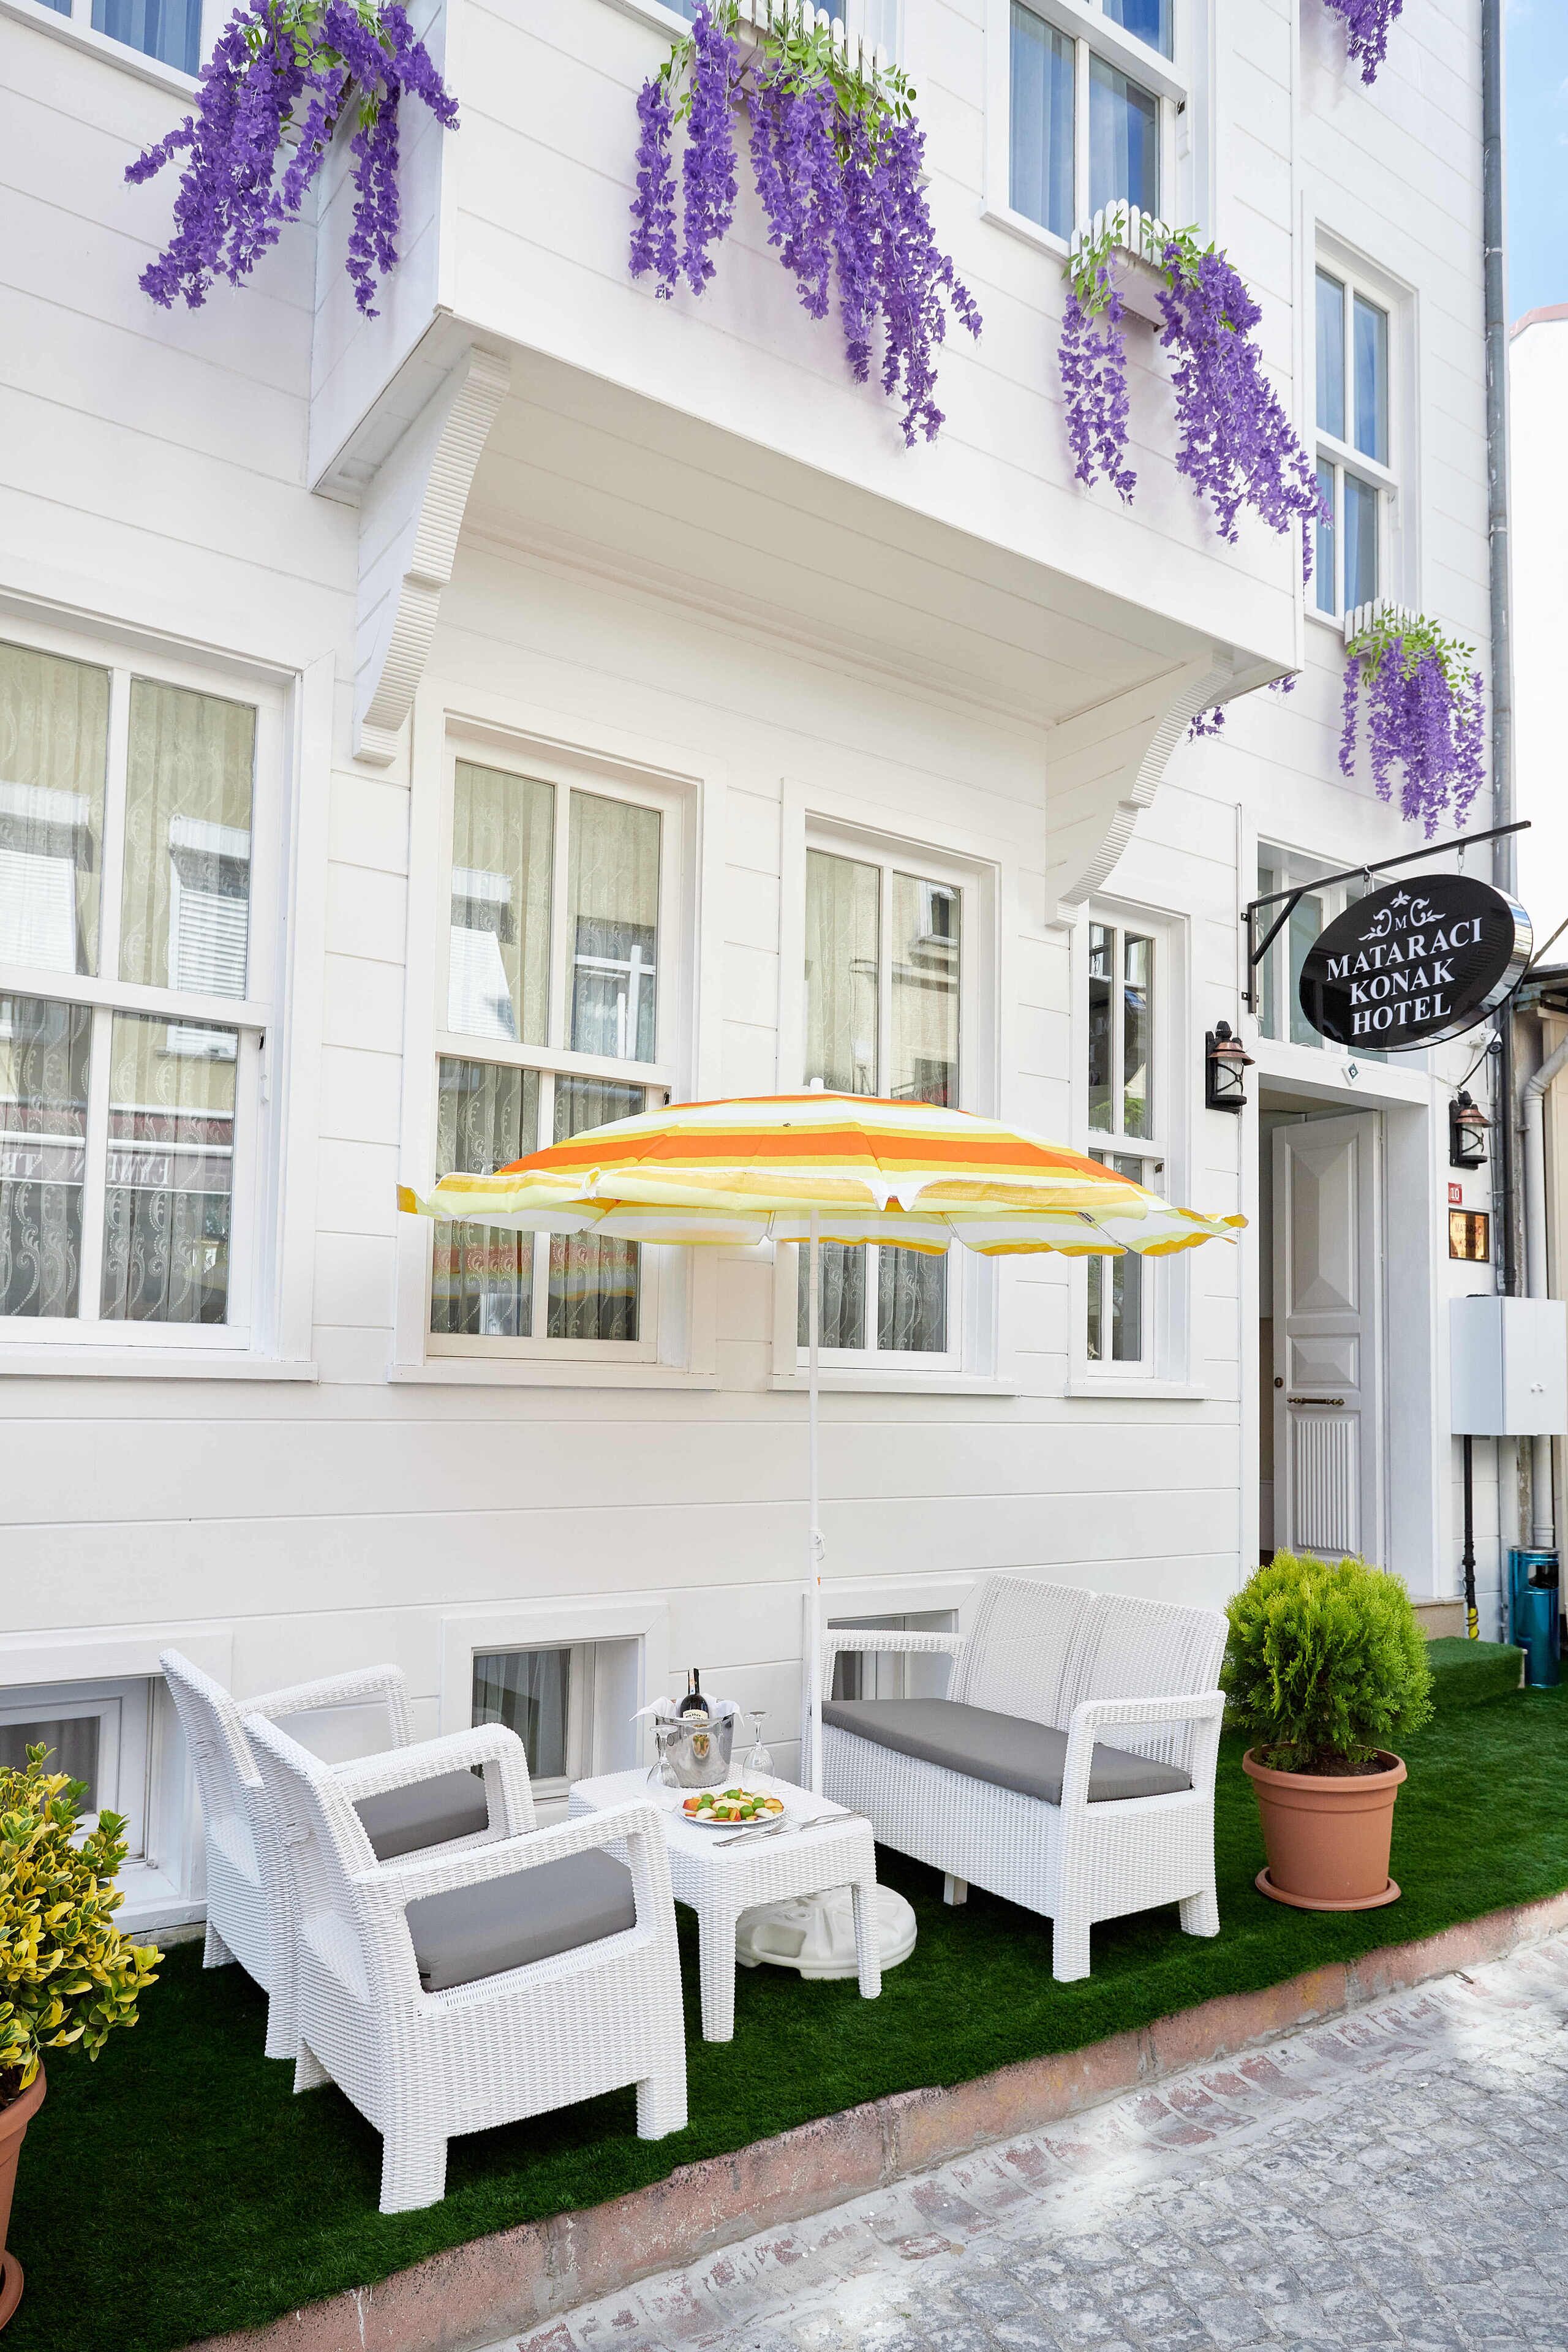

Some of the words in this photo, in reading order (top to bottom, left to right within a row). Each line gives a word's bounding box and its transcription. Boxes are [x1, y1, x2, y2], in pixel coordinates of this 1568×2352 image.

[1395, 914, 1408, 932] M
[1326, 917, 1483, 981] MATARACI
[1349, 957, 1455, 1006] KONAK
[1351, 993, 1452, 1036] HOTEL
[1450, 1188, 1460, 1199] 10
